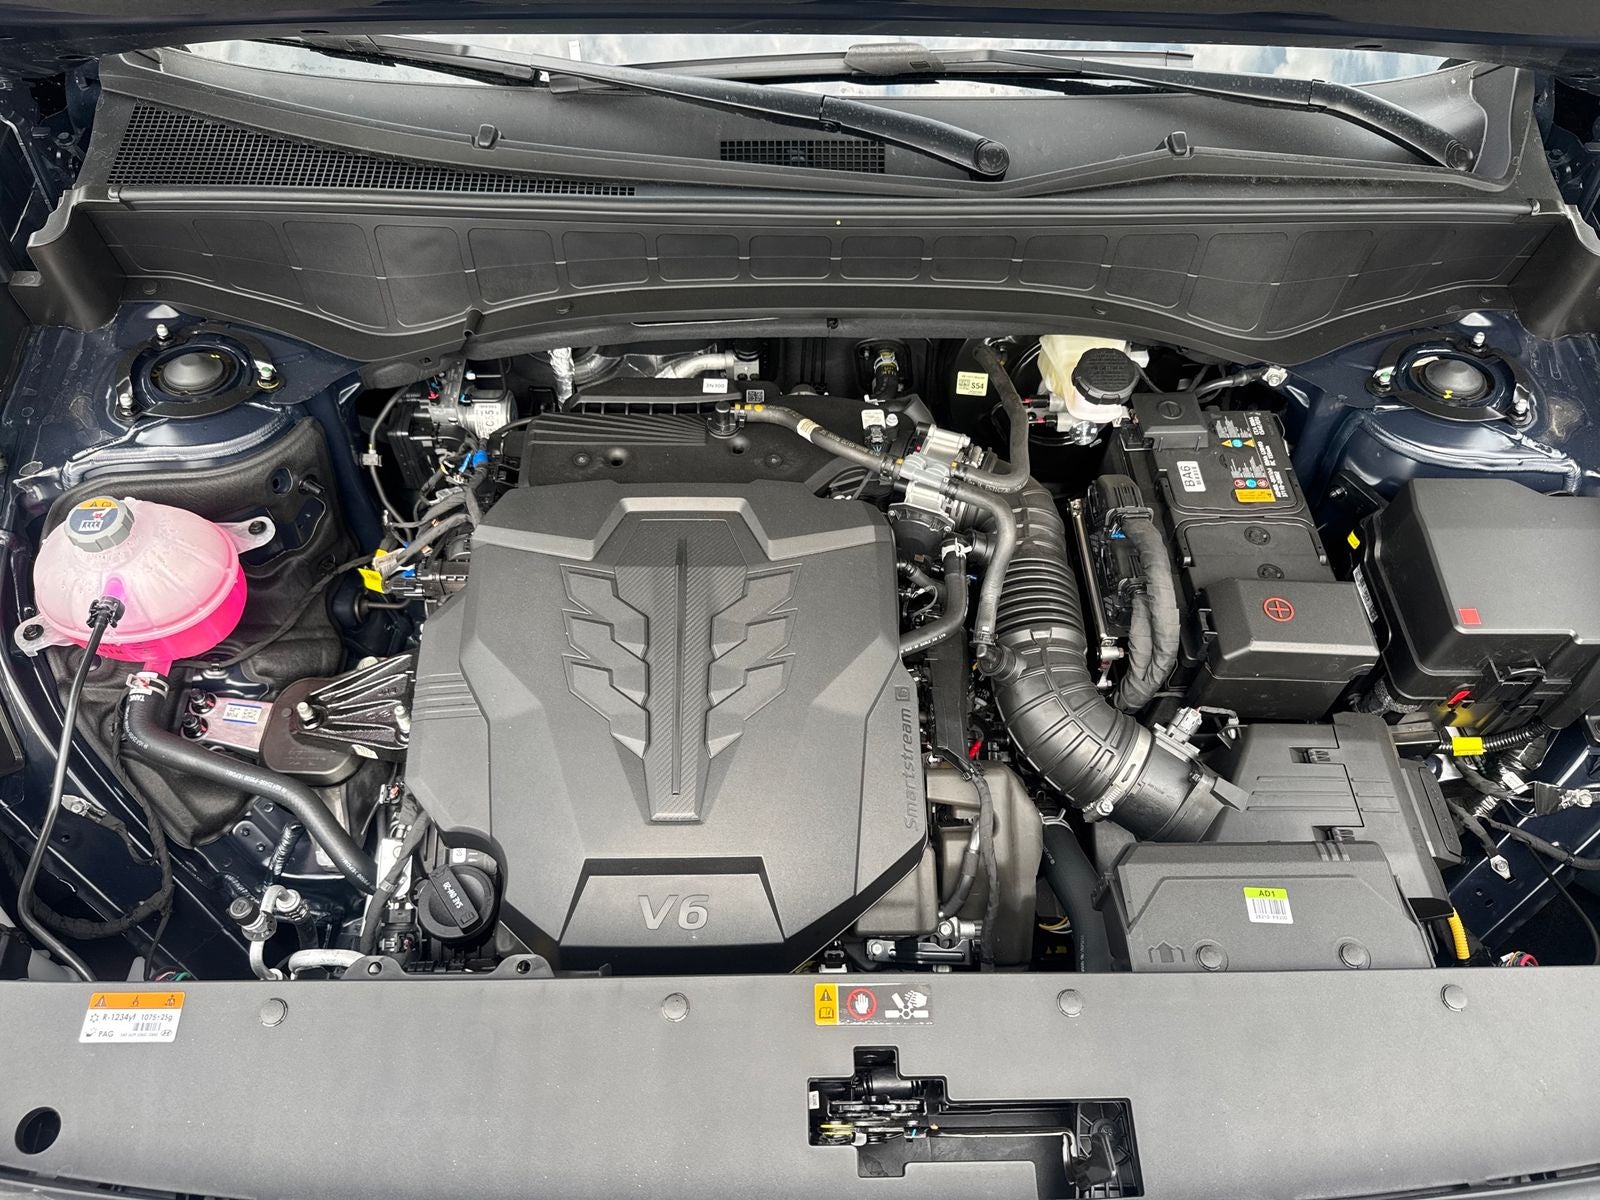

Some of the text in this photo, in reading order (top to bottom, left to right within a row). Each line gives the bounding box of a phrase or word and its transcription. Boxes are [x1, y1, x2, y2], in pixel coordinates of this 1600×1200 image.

[1180, 465, 1195, 487] BA6
[901, 708, 918, 830] Smartstream
[1258, 889, 1276, 898] AD1
[638, 894, 709, 930] V6
[102, 1013, 137, 1021] R-1234yf
[98, 1030, 114, 1038] PAG
